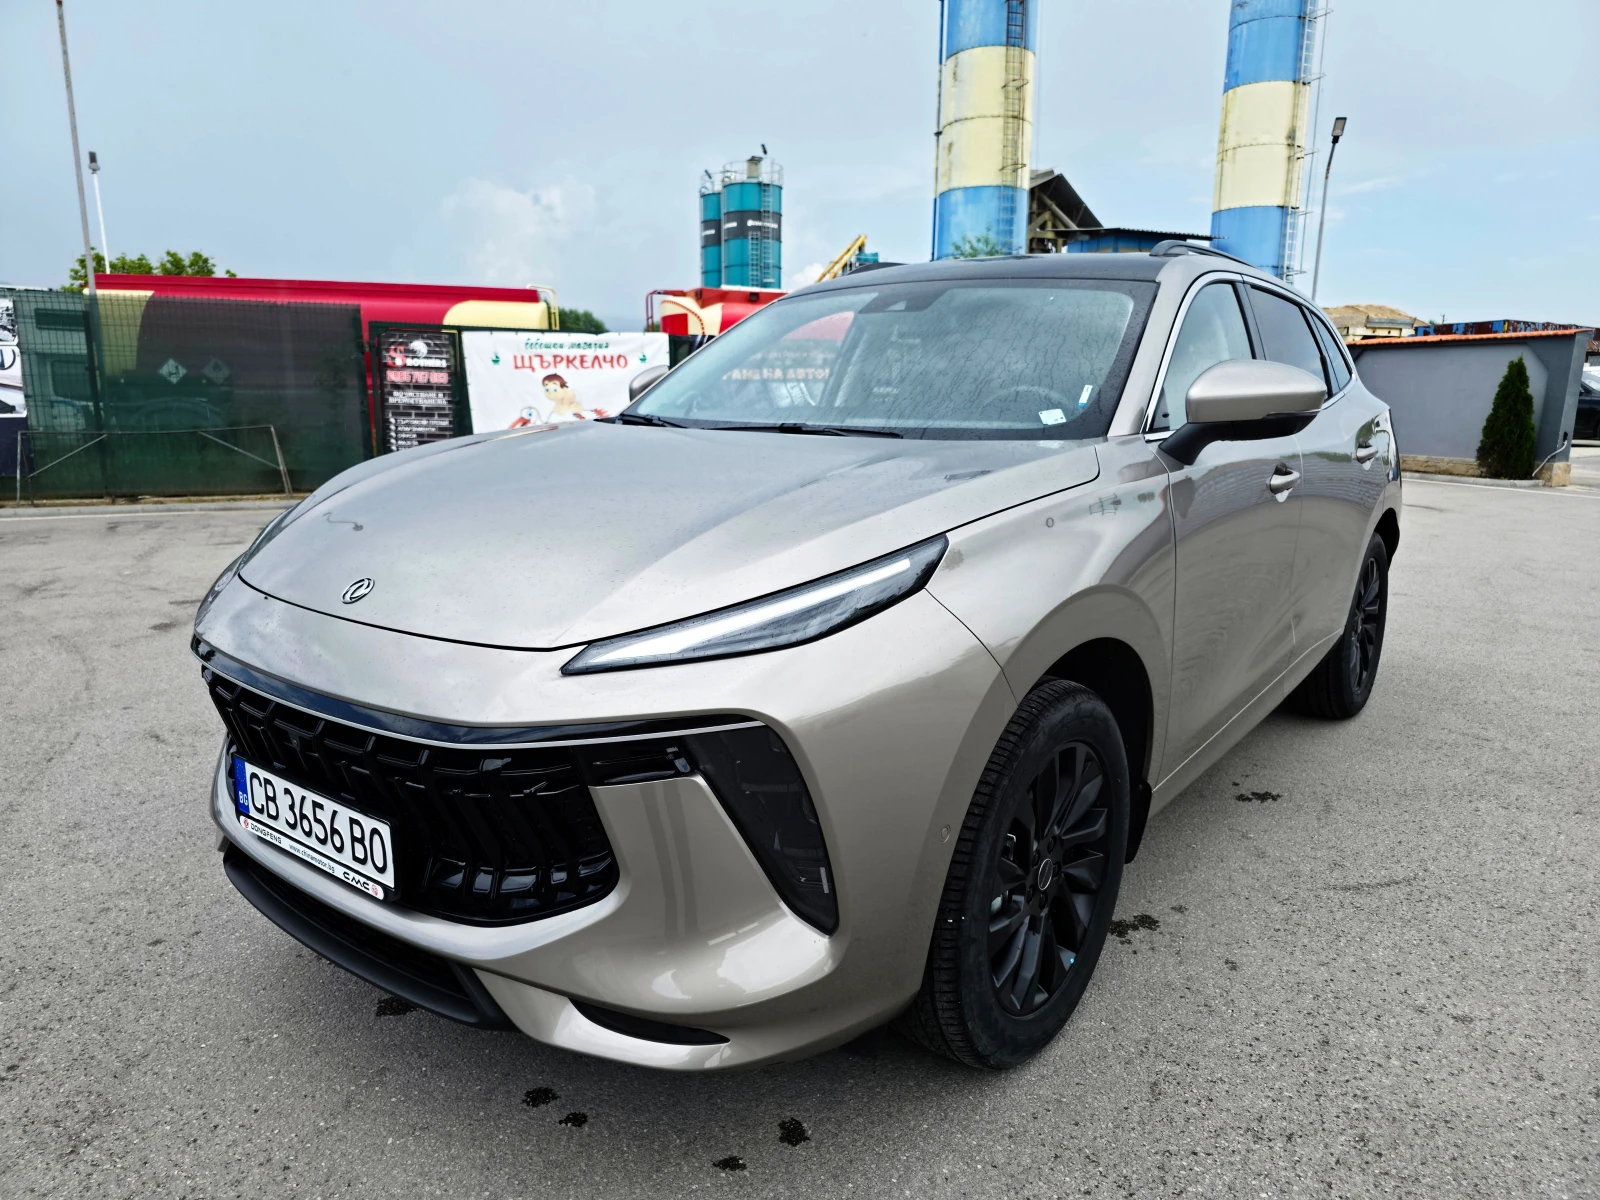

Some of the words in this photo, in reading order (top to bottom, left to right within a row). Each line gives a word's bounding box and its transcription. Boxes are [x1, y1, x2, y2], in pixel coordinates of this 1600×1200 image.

[513, 354, 628, 372] ЩЪРКЕЛЧО
[239, 791, 248, 806] BG
[249, 771, 280, 821] CB
[283, 787, 345, 854] 3656
[349, 816, 387, 874] BO
[250, 822, 282, 845] DONGFENG
[343, 871, 370, 891] CMC
